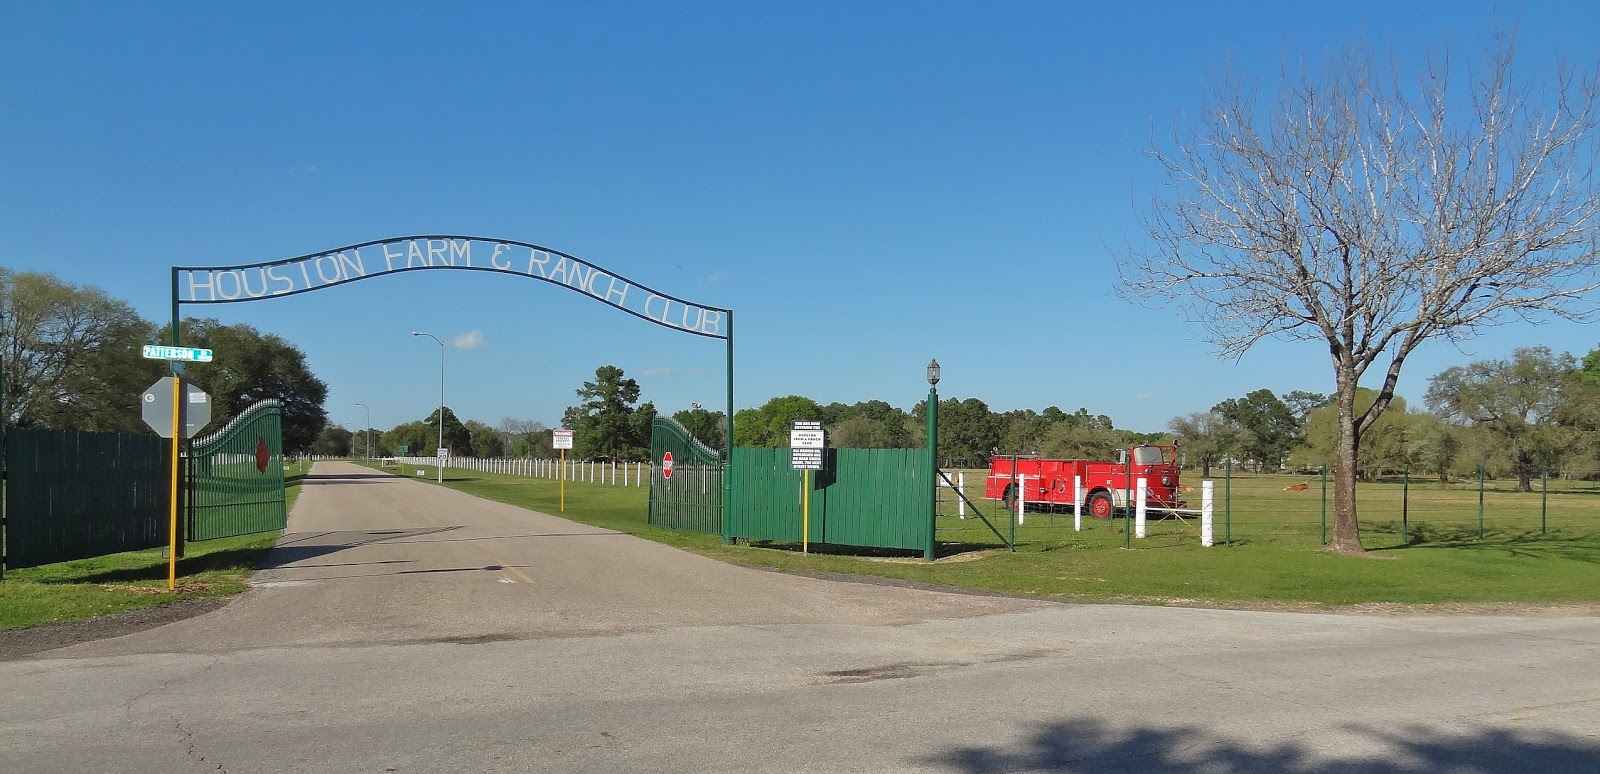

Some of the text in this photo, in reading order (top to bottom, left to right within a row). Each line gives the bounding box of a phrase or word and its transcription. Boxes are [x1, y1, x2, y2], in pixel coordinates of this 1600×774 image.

[188, 239, 720, 335] HOUSTON FARM & RANCH CLUB
[145, 347, 193, 359] PATTERSON
[663, 460, 672, 470] STOP
